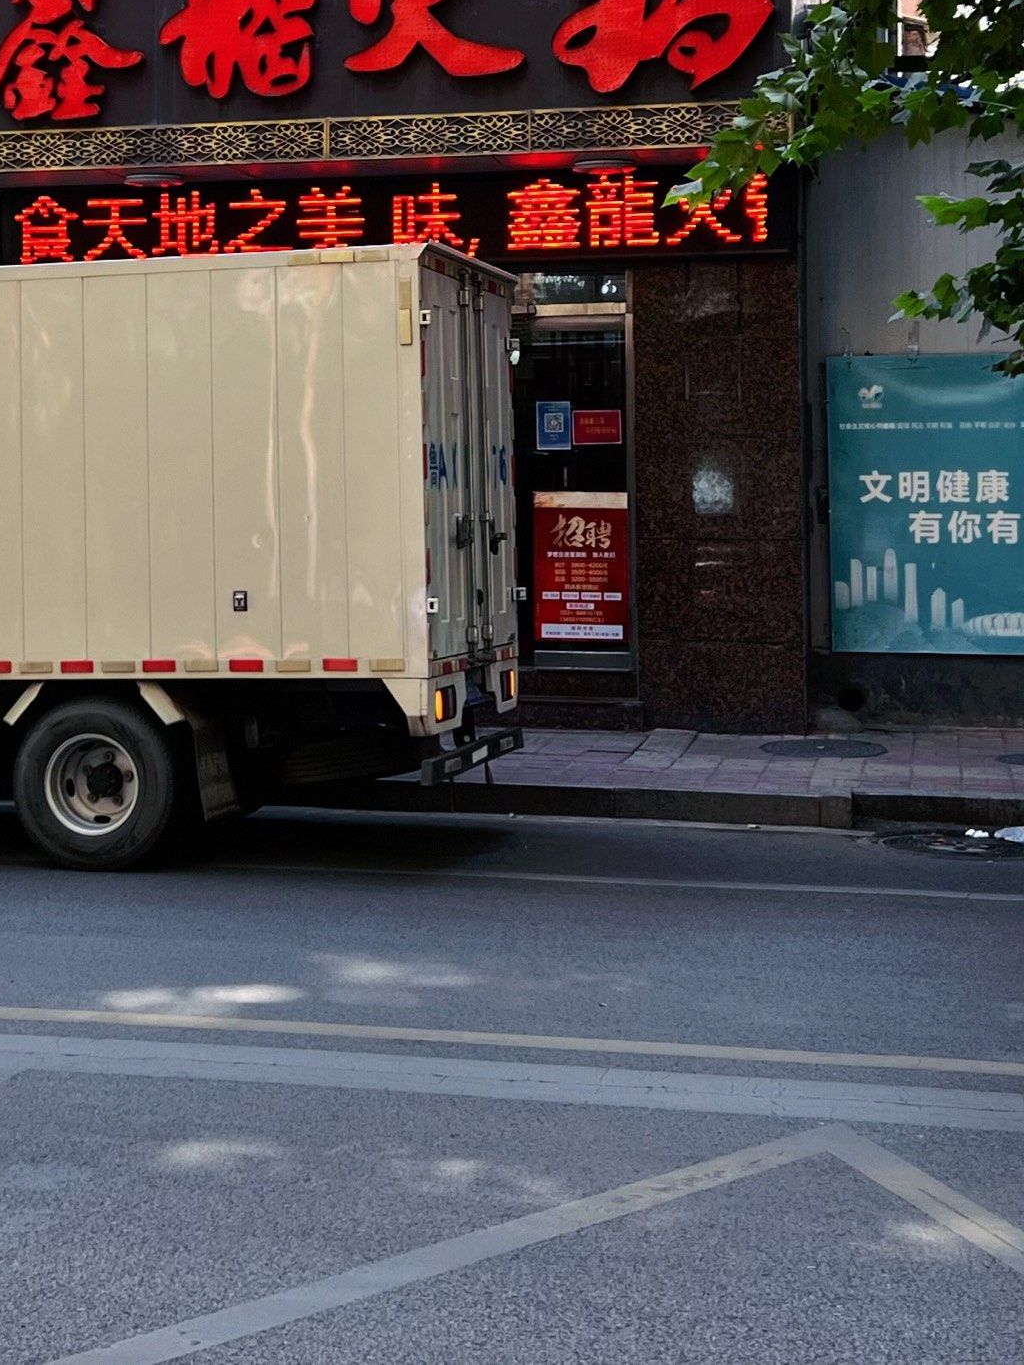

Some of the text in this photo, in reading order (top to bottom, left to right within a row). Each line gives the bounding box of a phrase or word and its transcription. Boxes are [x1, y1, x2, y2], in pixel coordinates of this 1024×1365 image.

[859, 470, 1009, 503] 文明健康
[549, 514, 612, 549] 招聘
[909, 510, 1021, 544] 有你有
